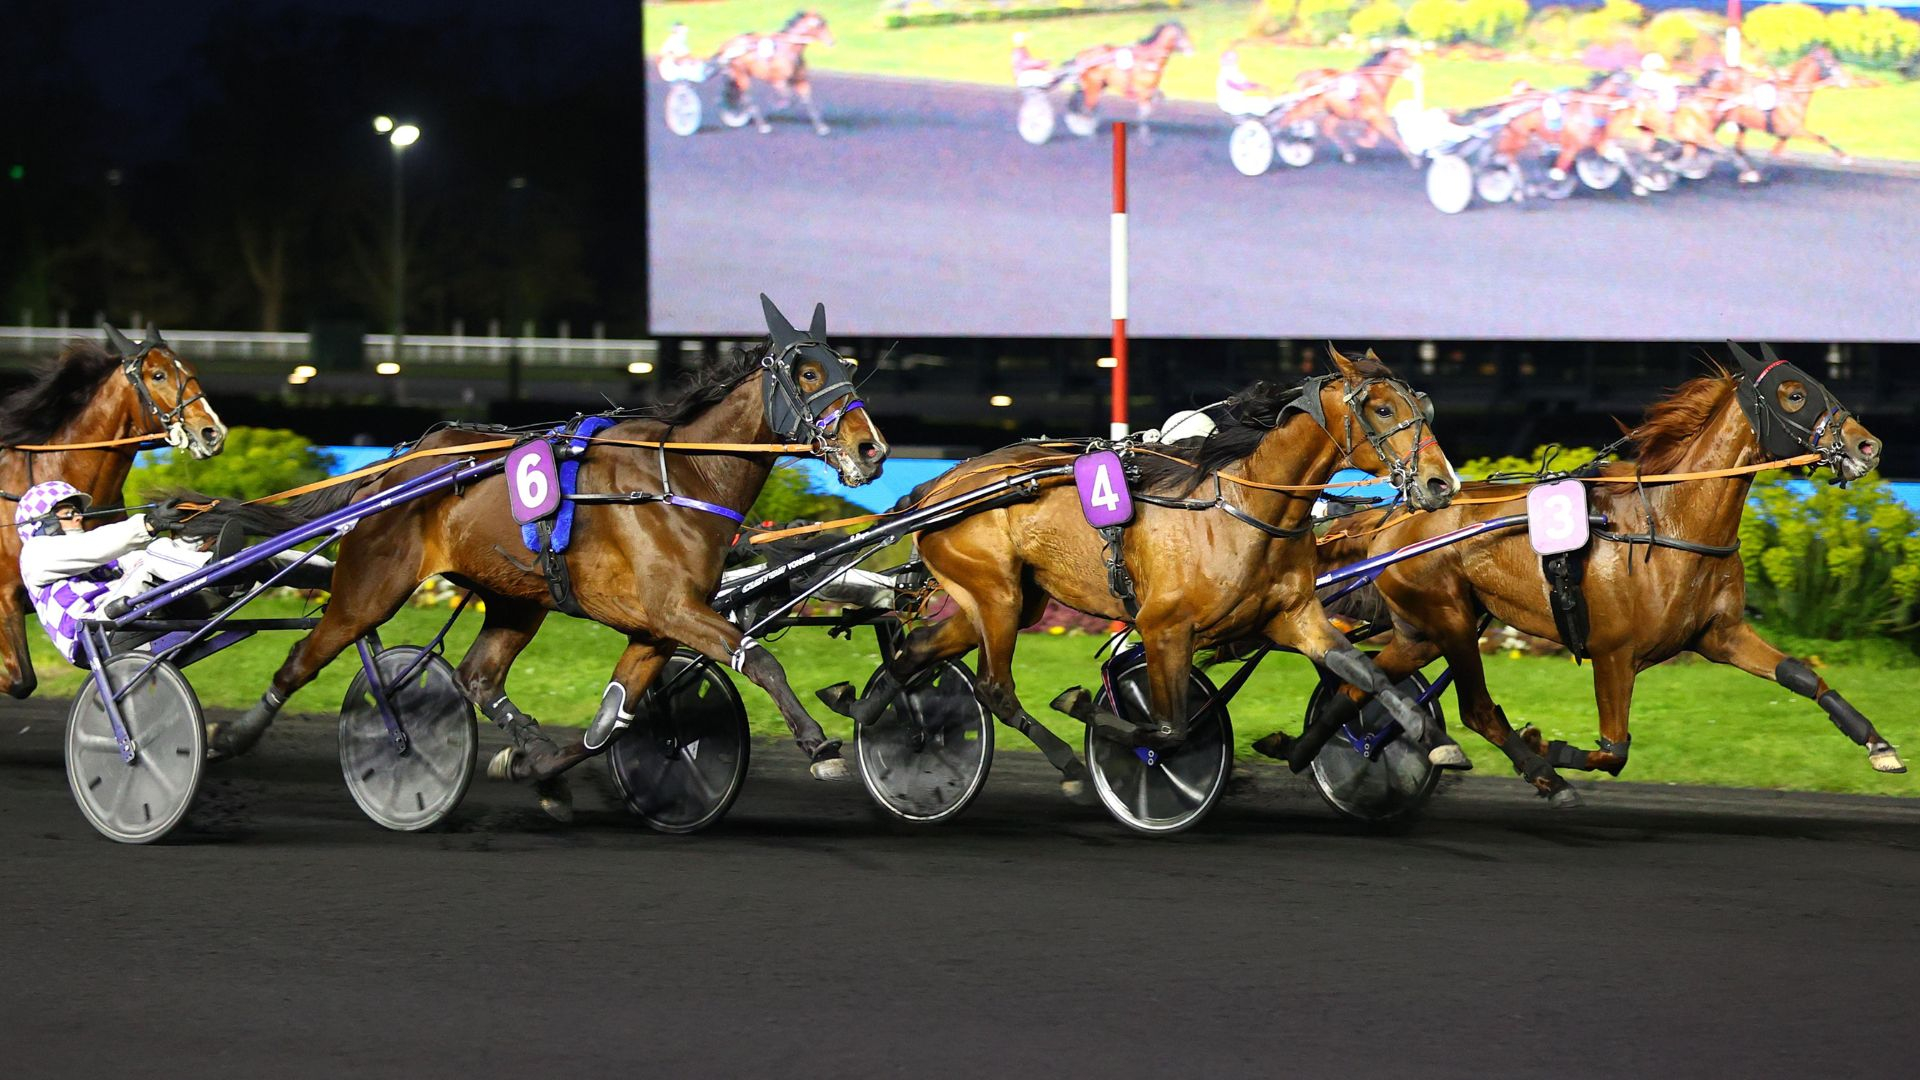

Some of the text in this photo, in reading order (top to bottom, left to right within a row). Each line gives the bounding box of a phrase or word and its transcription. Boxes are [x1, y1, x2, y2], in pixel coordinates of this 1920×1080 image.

[516, 453, 548, 508] 6
[1091, 464, 1120, 511] 4
[1545, 494, 1574, 539] 3
